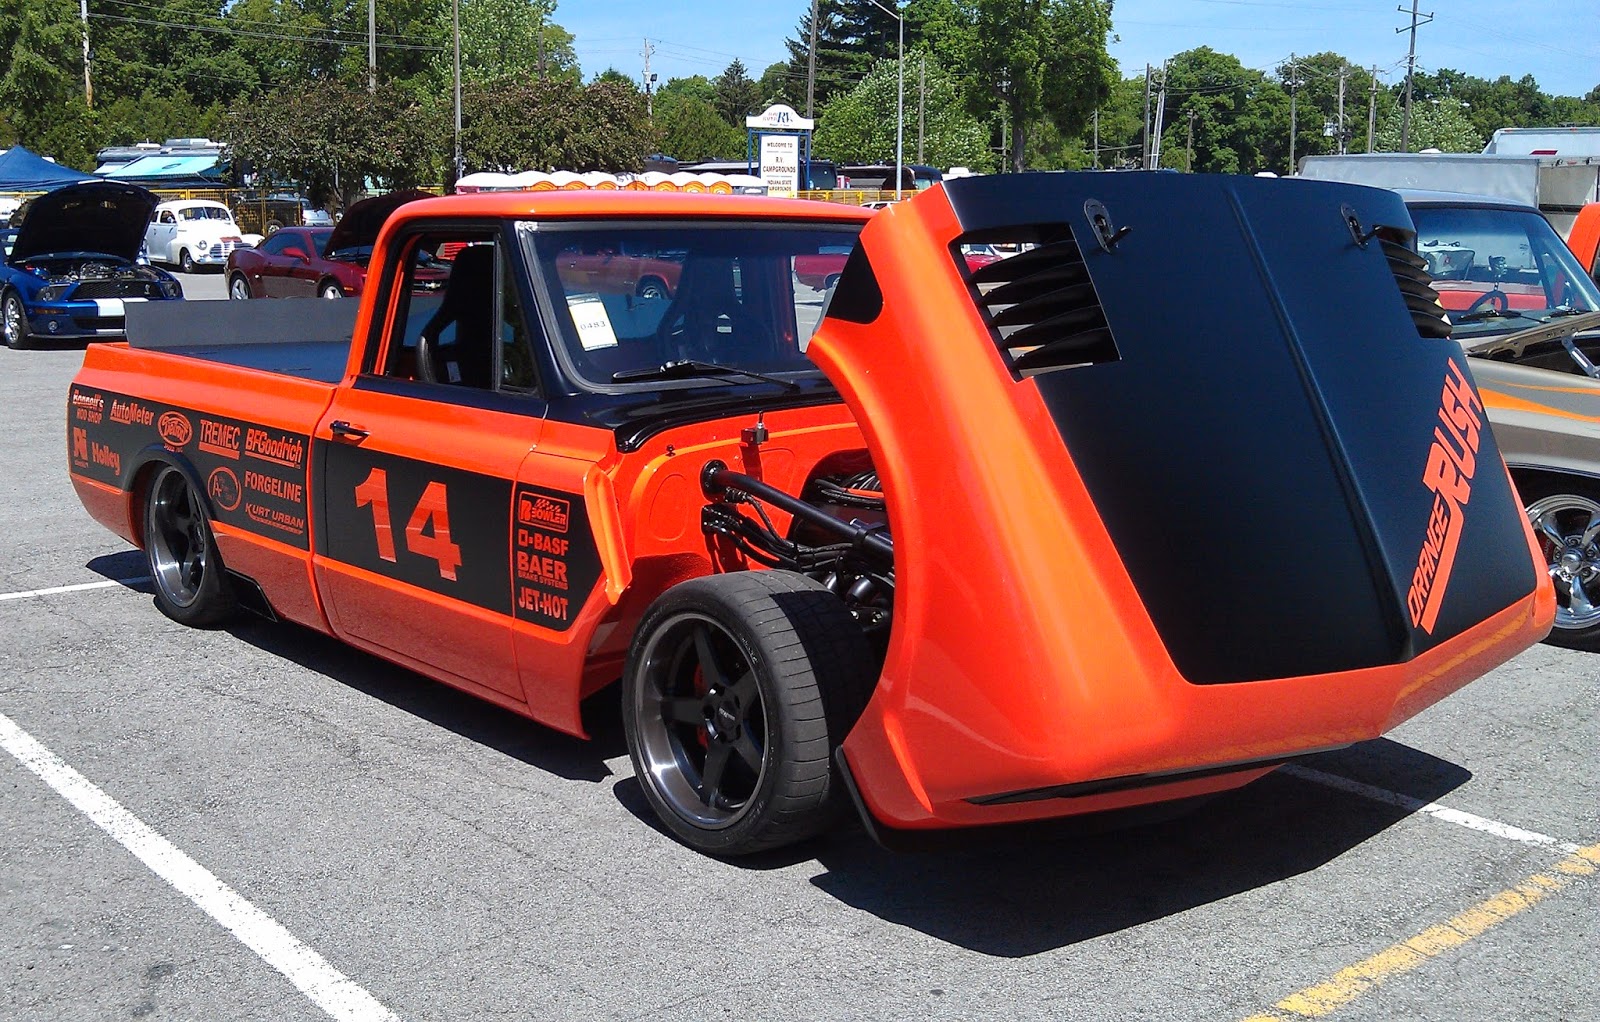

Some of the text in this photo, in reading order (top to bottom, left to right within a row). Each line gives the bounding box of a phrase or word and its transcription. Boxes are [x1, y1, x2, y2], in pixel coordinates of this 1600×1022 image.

[763, 165, 796, 173] CAMPGROUNDS
[110, 399, 155, 426] AutoMeter
[200, 419, 241, 451] TREMEC
[245, 428, 303, 464] BFGoodrich
[1421, 356, 1483, 520] RUSH
[92, 441, 121, 476] Holley
[245, 470, 302, 503] FORGELINE
[245, 502, 271, 518] KURT
[271, 510, 304, 529] URBAN
[355, 467, 462, 581] 14
[517, 551, 568, 583] BAER
[1407, 494, 1449, 629] ORANGE
[517, 570, 569, 590] BRAKE SYSTEMS
[518, 587, 569, 621] JET-HOT
